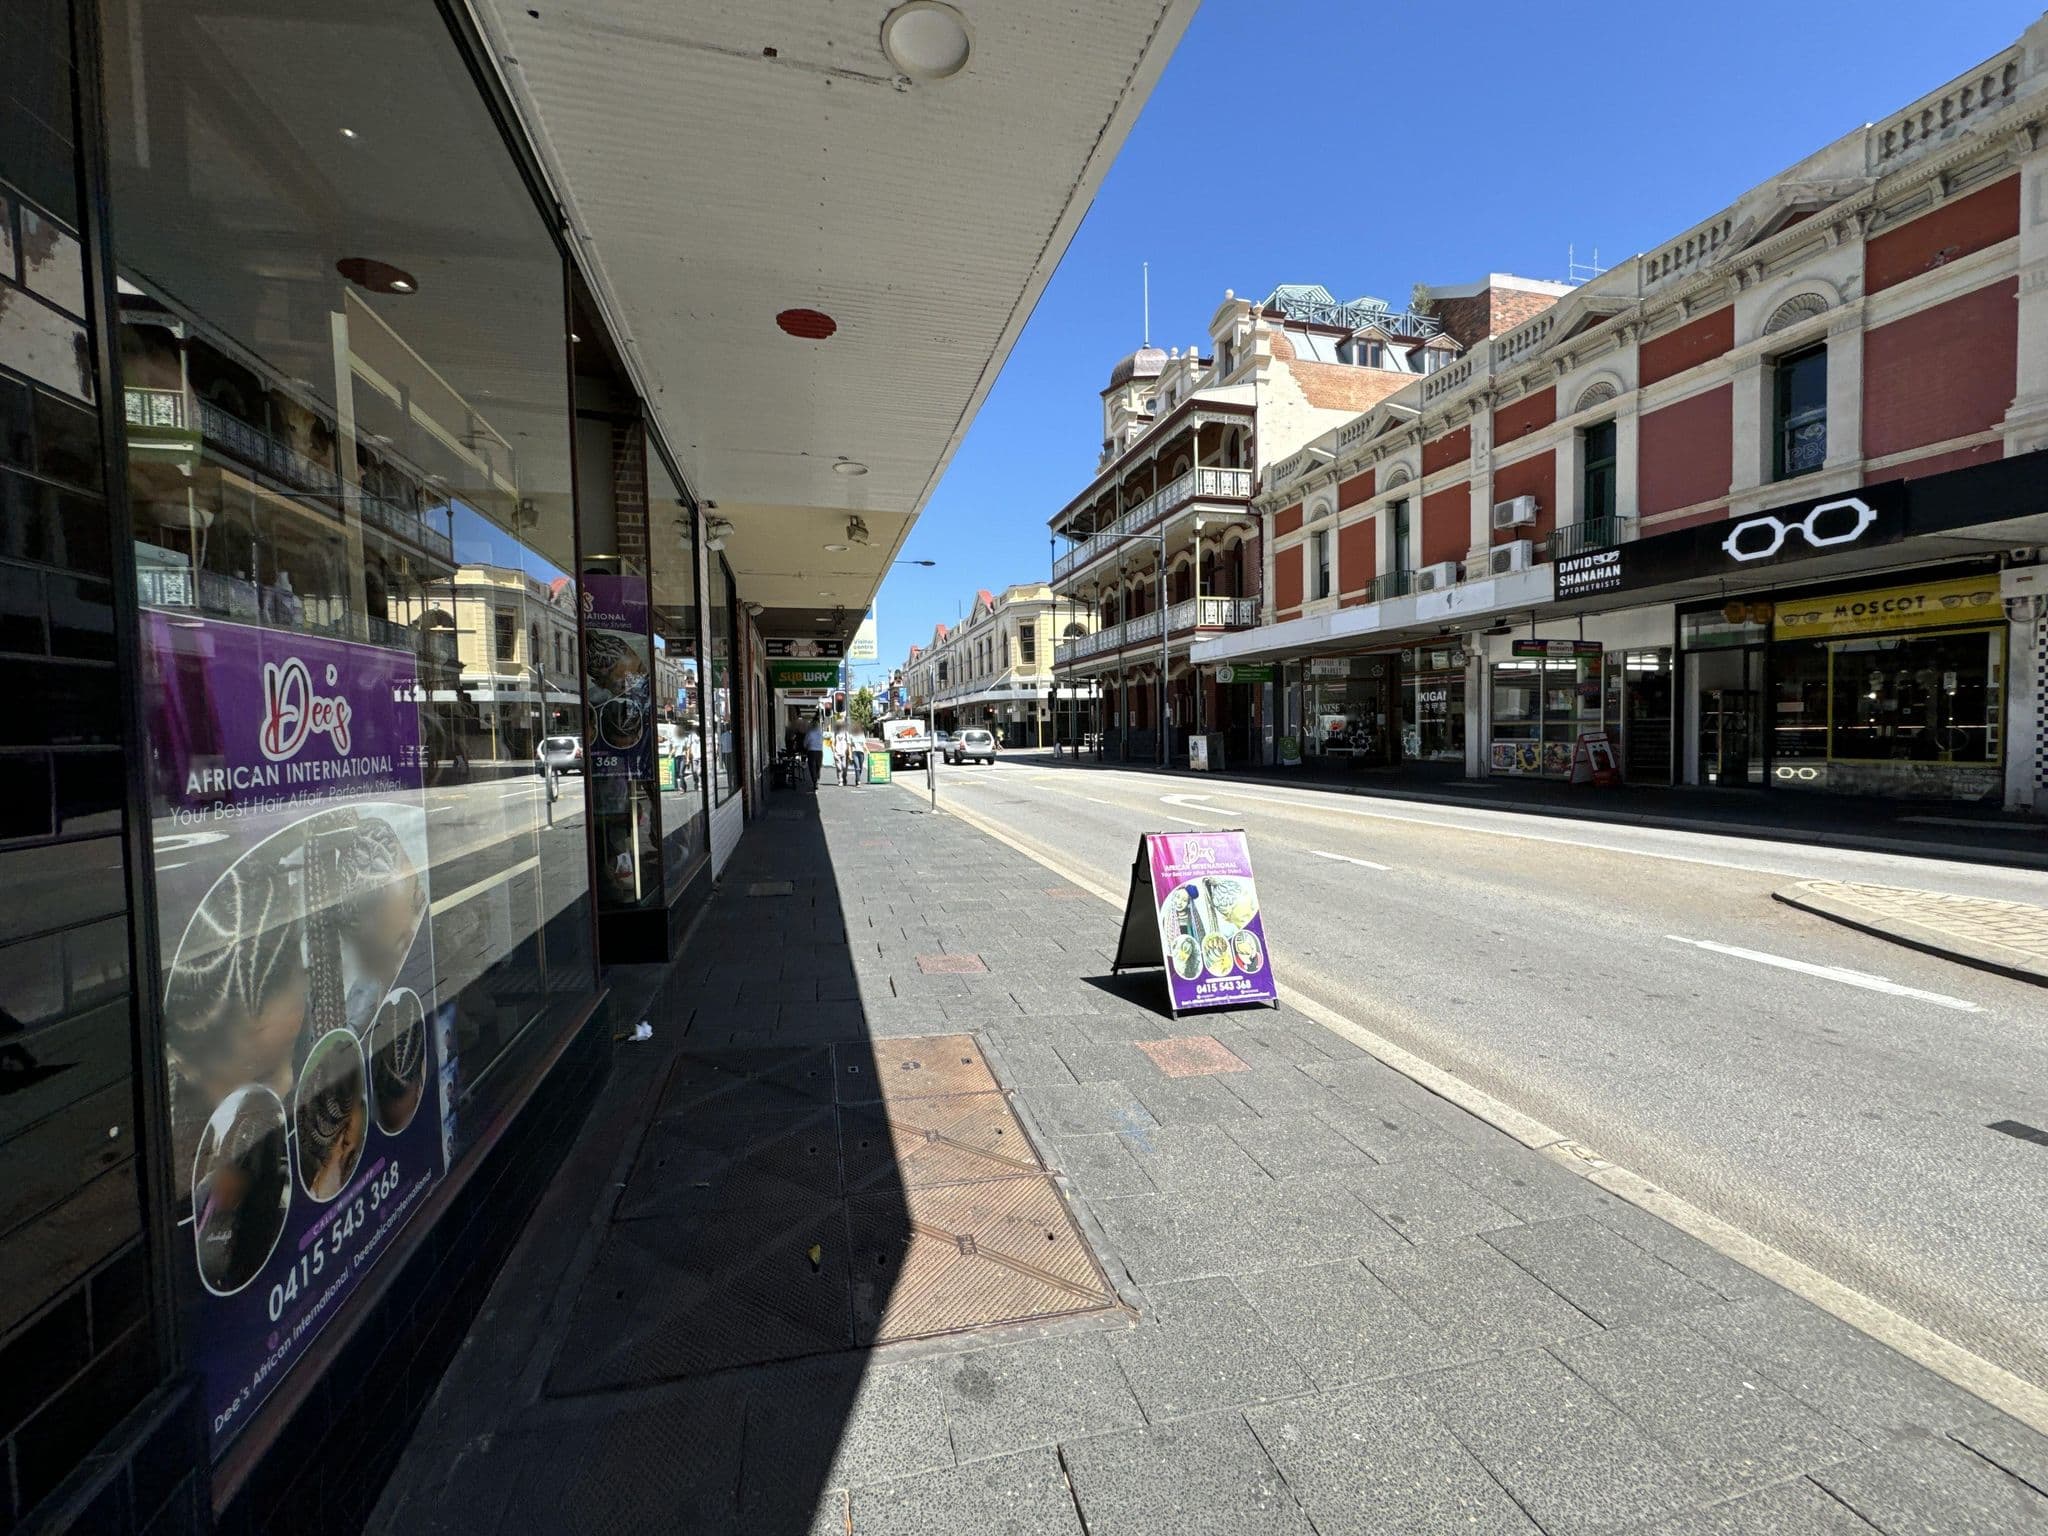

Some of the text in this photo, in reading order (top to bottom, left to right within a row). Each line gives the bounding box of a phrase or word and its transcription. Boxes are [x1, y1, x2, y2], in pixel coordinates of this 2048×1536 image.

[1560, 556, 1592, 573] DAVID
[1560, 564, 1620, 587] SHANAHAN
[1560, 579, 1620, 596] OPTOMETRISTS
[1833, 594, 1926, 618] MOSCOT
[780, 671, 833, 684] SUBWAY
[1417, 690, 1447, 702] IKIGAI
[259, 656, 352, 762] Dee's
[186, 755, 393, 795] AFRICAN INTERNATIONAL
[170, 804, 208, 827] Your
[214, 797, 248, 821] Best
[254, 792, 285, 813] Hair
[329, 781, 373, 801] Perfectly
[1196, 983, 1217, 994] 0415
[1219, 981, 1235, 991] 543
[1236, 979, 1252, 990] 368
[269, 1238, 324, 1322] 0415
[332, 1197, 364, 1254] 543
[370, 1161, 399, 1211] 368
[214, 1386, 250, 1434] Dee's
[253, 1337, 291, 1389] African
[292, 1265, 349, 1341] International
